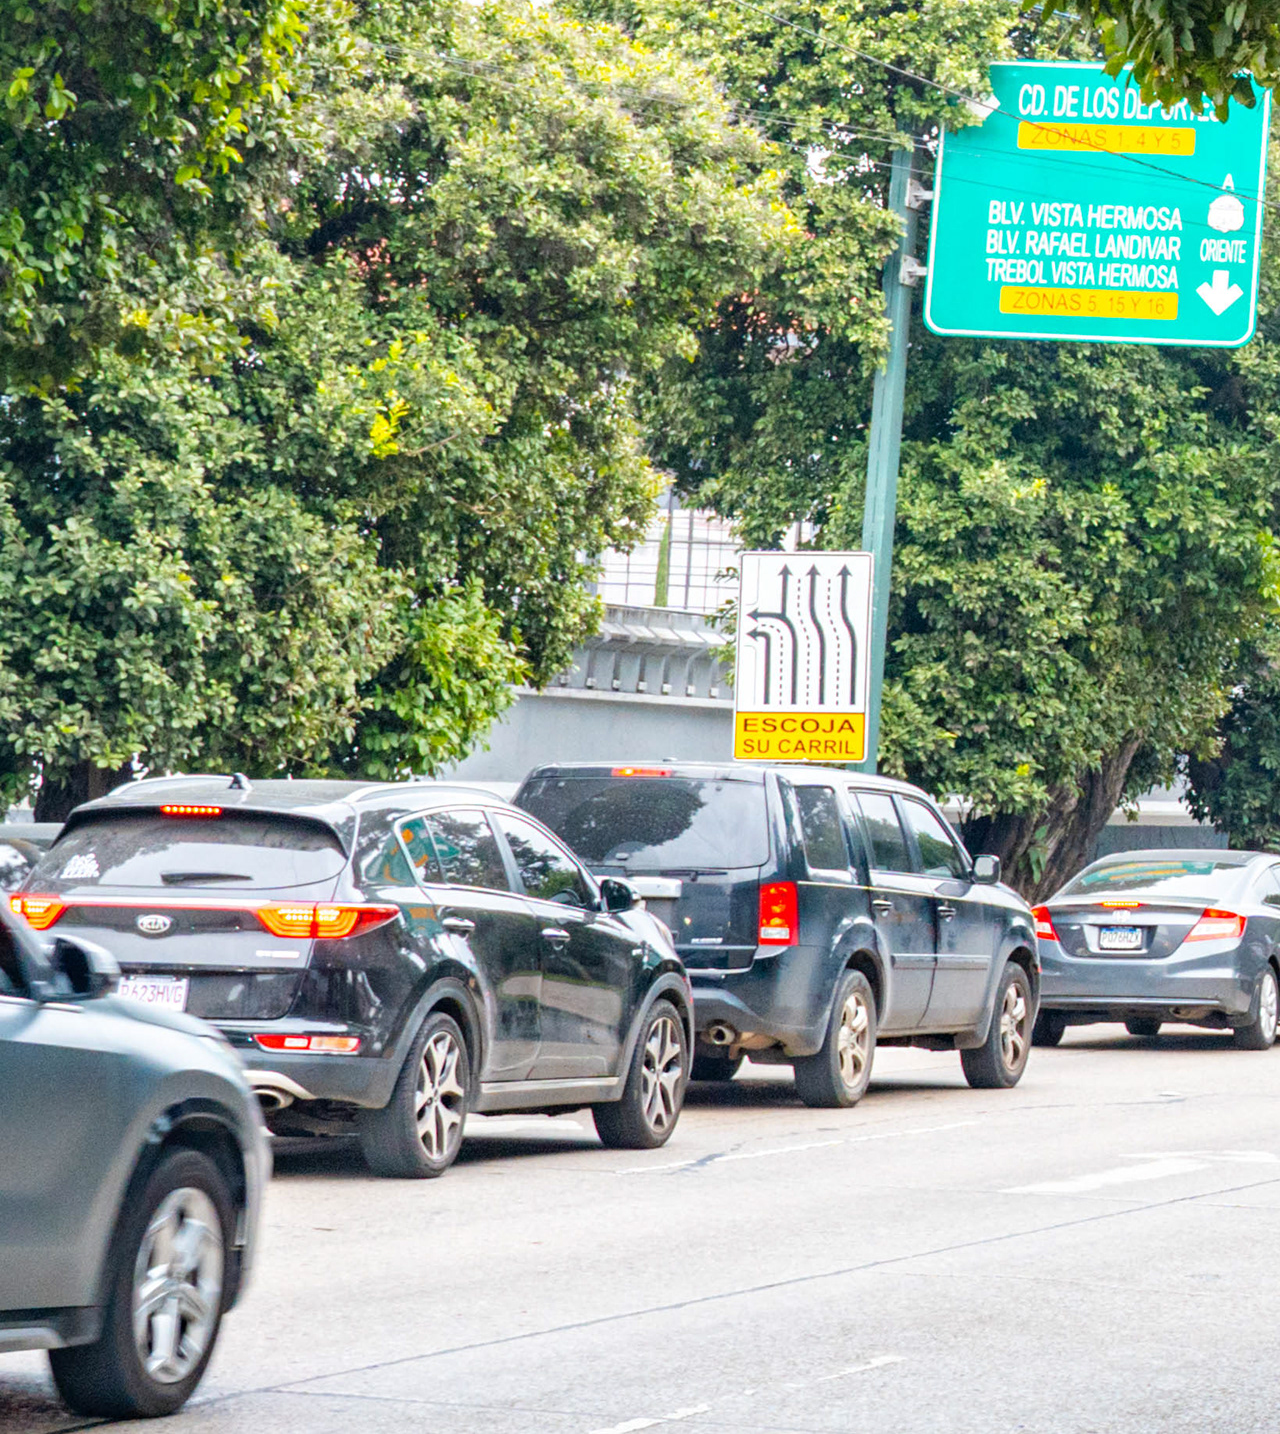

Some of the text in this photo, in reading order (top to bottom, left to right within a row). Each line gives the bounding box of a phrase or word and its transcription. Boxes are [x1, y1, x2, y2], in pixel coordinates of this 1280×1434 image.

[1018, 83, 1048, 116] CD.
[1053, 85, 1080, 118] DE
[1083, 86, 1120, 119] LOS
[1031, 127, 1107, 146] ZONAS
[1136, 133, 1146, 146] 4
[1153, 133, 1168, 147] Y
[1171, 133, 1182, 150] 5
[1222, 173, 1235, 191] A
[988, 200, 1025, 226] BLV.
[1031, 202, 1084, 229] VISTA
[1087, 204, 1183, 232] HERMOSA
[986, 230, 1181, 262] BLV. RAFAEL LANDIVAR
[1200, 238, 1247, 264] ORIENTE
[985, 257, 1179, 289] TREBOL VISTA HERMOSA
[1012, 291, 1082, 312] ZONAS
[1107, 294, 1126, 313] 15
[1131, 295, 1147, 313] Y
[1147, 296, 1166, 314] 16
[743, 717, 856, 734] ESCOJA
[743, 738, 857, 755] SU CARRIL
